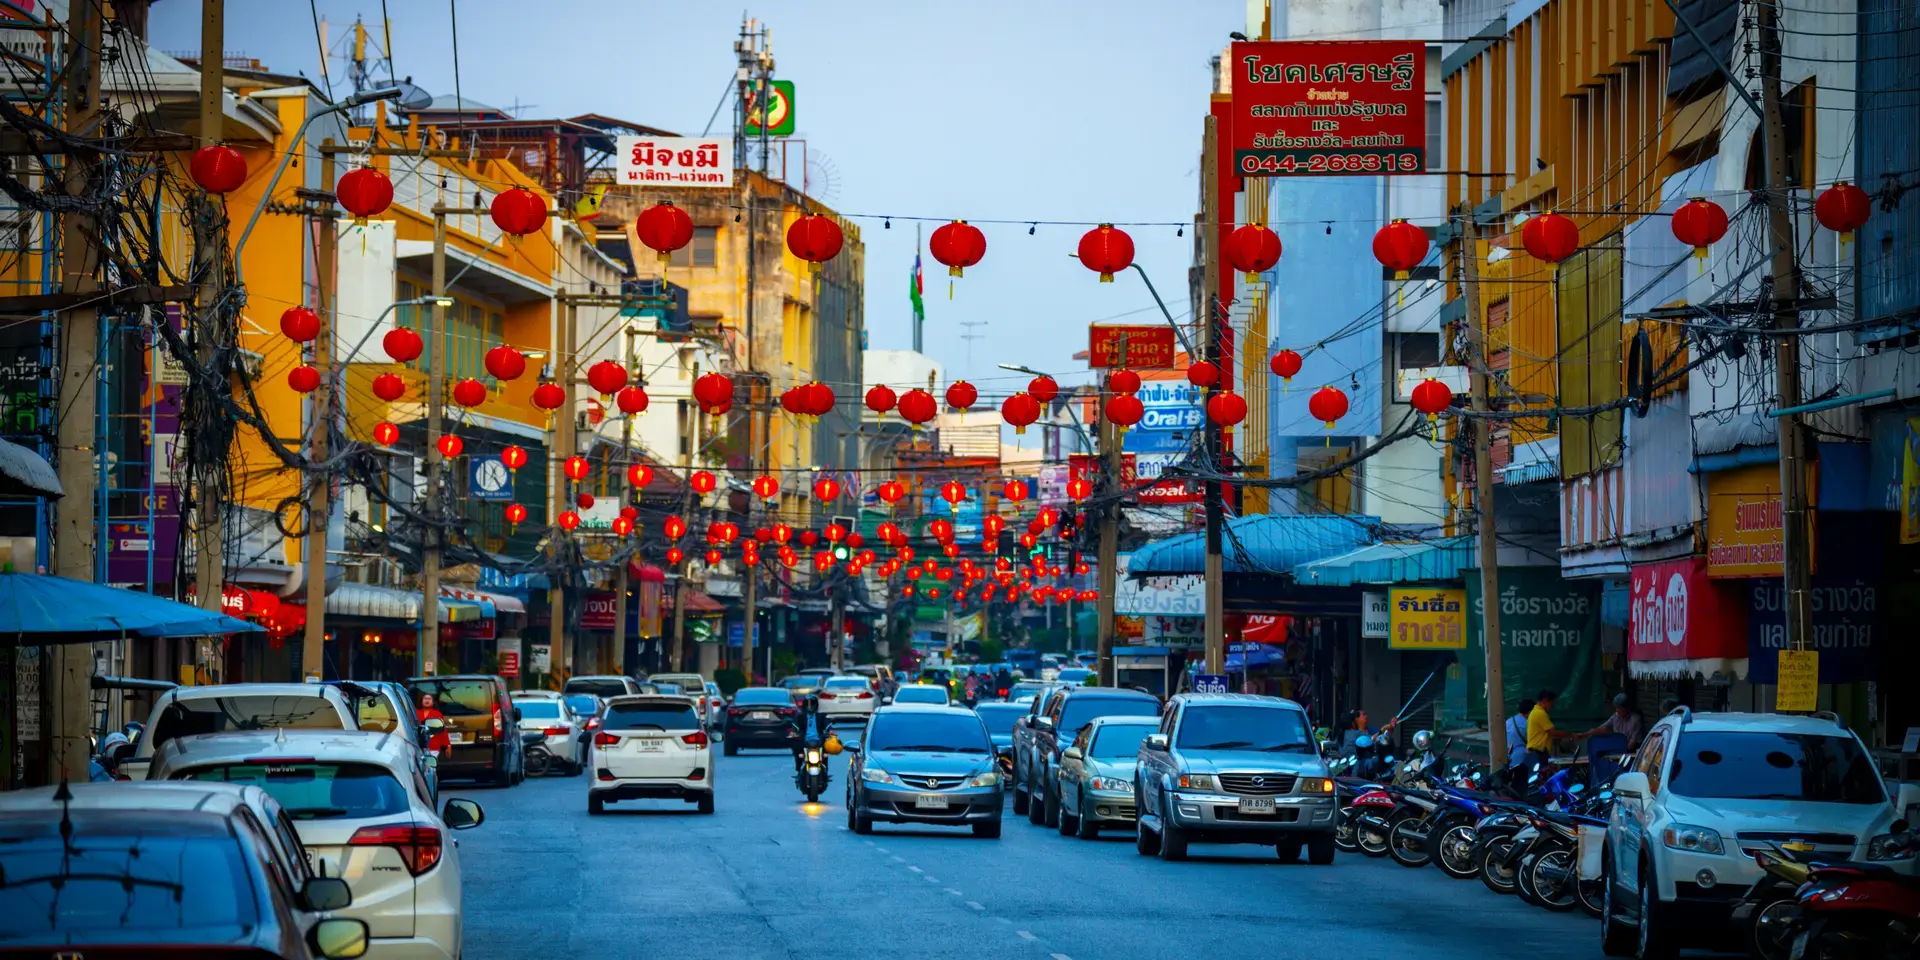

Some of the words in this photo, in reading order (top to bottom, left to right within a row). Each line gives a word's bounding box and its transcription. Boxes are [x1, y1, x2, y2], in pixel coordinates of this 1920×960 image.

[1244, 53, 1415, 90] โชคเศรษฐี
[1250, 100, 1407, 121] สลากกินแบ่งรัฐบาล
[1312, 120, 1339, 131] และ
[1253, 129, 1404, 148] รับซื้อรางวัล-เลขท้าย
[631, 142, 718, 168] มีจงมี
[1241, 154, 1418, 172] 044-268313
[1398, 592, 1460, 612] รับซื้อ
[1632, 570, 1663, 644] รับซื้อ
[1398, 616, 1461, 642] รางวัล
[1512, 622, 1581, 648] เลขท้าย
